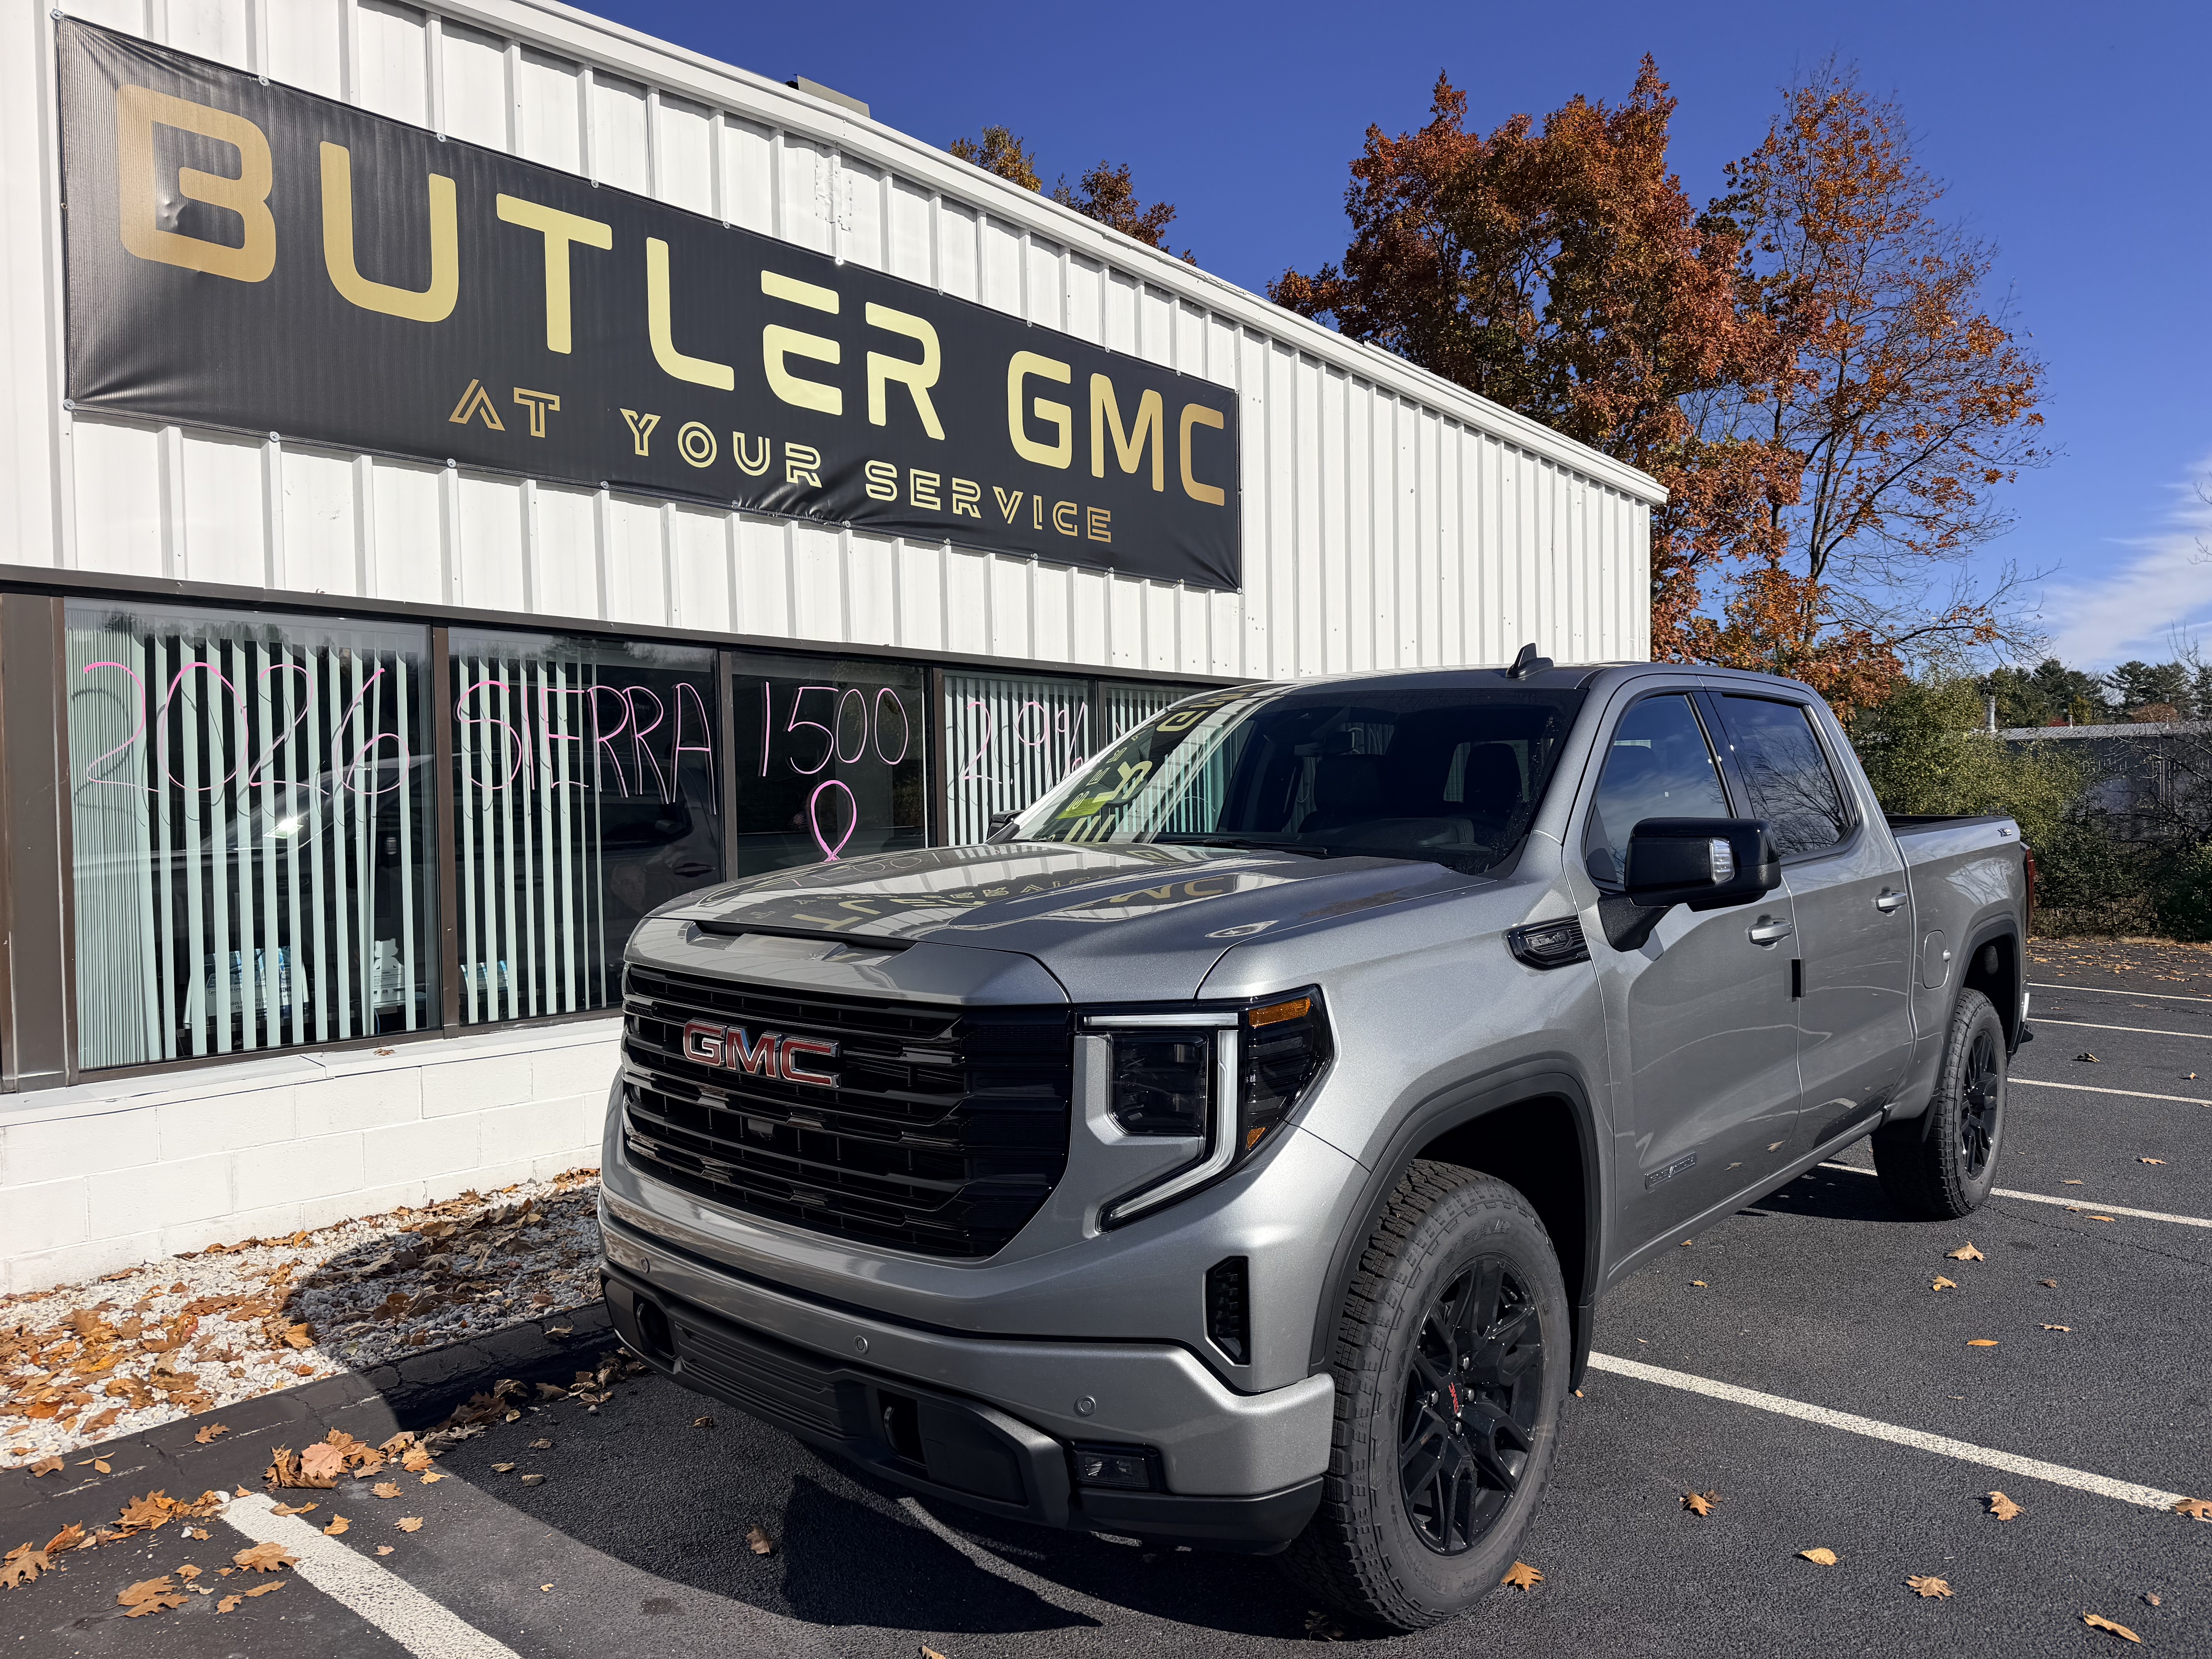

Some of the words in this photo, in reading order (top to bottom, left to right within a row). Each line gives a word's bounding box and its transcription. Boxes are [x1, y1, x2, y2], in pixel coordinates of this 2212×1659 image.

[116, 84, 945, 440] BUTLER
[1008, 350, 1225, 507] GMC
[449, 379, 560, 438] AT
[620, 408, 822, 488] YOUR
[865, 460, 1112, 543] SERVICE
[84, 661, 410, 795] 2026
[457, 680, 718, 815] SIERRA
[763, 682, 908, 777] 1500
[683, 1017, 841, 1089] GMC
[1448, 1381, 1459, 1413] GMC
